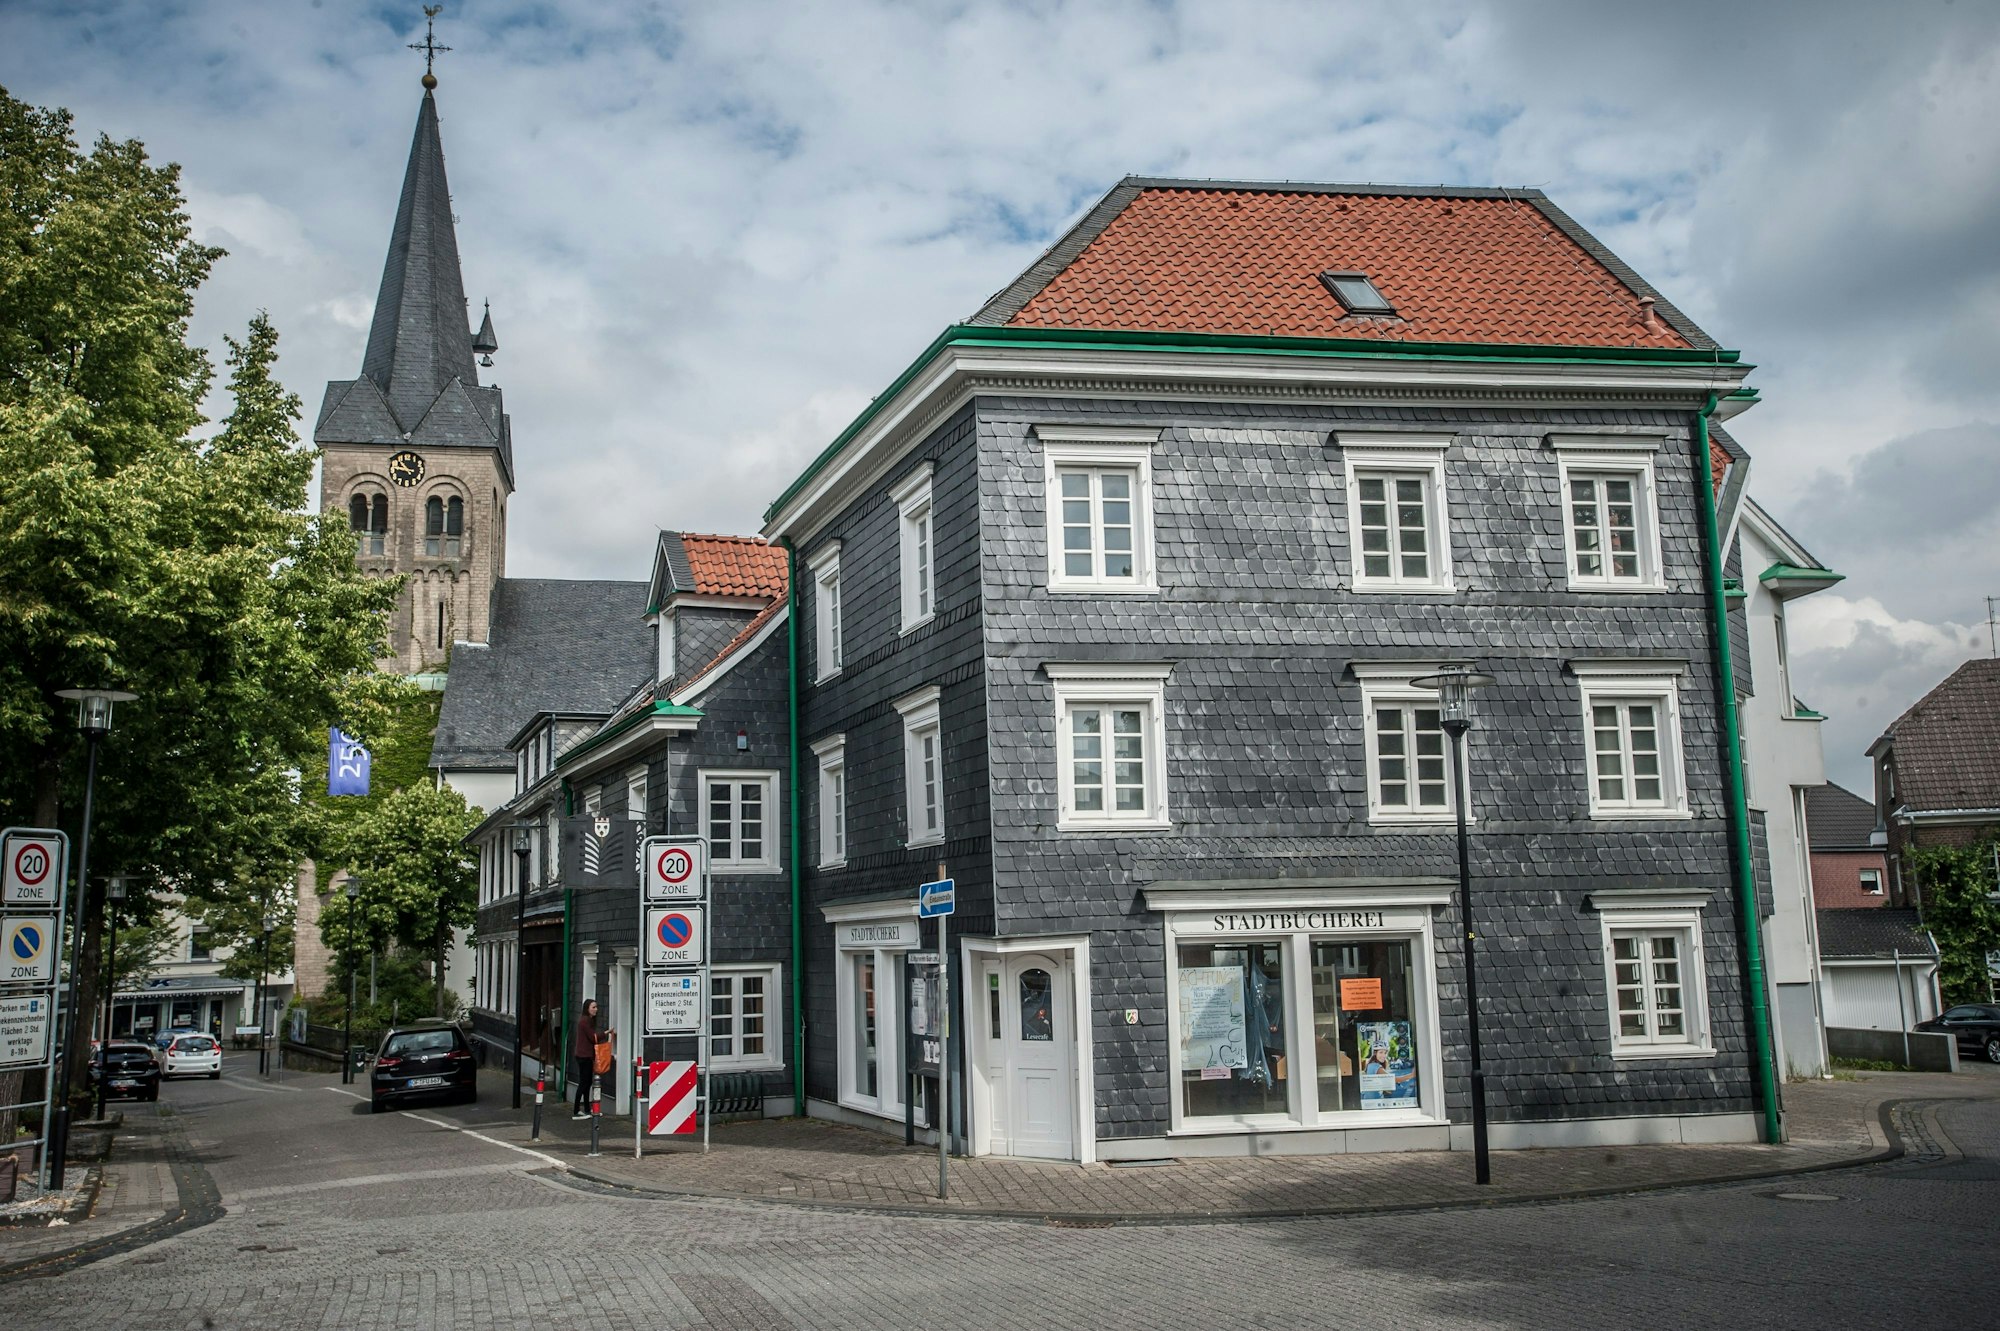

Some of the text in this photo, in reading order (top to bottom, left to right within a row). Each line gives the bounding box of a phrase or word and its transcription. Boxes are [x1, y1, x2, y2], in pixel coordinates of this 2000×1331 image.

[22, 855, 43, 874] 20
[665, 858, 686, 874] 20
[17, 887, 44, 898] ZONE
[661, 885, 688, 895] ZONE
[1213, 911, 1385, 931] STADTBÜCHEREI
[850, 924, 900, 942] STADTBÜCHEREI
[661, 951, 688, 960] ZONE
[11, 966, 39, 978] ZONE
[650, 990, 699, 1000] gekennzeichneten
[19, 1003, 29, 1011] mit
[39, 1002, 45, 1010] in
[655, 999, 676, 1007] Flächen
[661, 1008, 687, 1017] werktags
[0, 1014, 46, 1024] ekennzeichneten
[1, 1024, 40, 1035] Flächen 2 Std.
[7, 1037, 33, 1047] werktags
